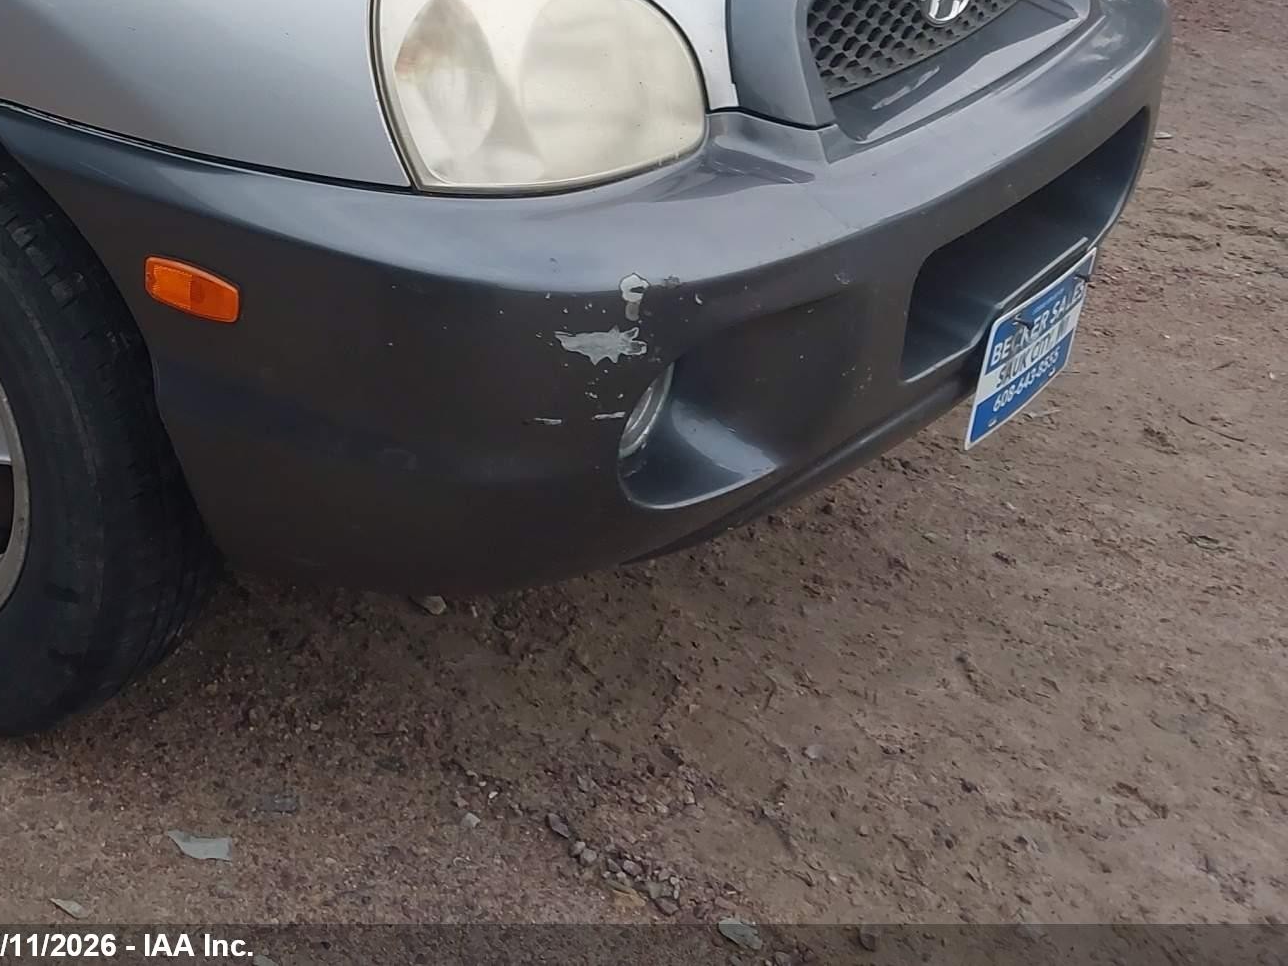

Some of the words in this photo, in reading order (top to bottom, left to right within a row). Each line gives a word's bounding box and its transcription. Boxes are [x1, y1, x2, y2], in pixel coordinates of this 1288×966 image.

[990, 311, 1050, 367] BECKER
[1050, 283, 1085, 322] SALES
[995, 351, 1029, 389] SAUK
